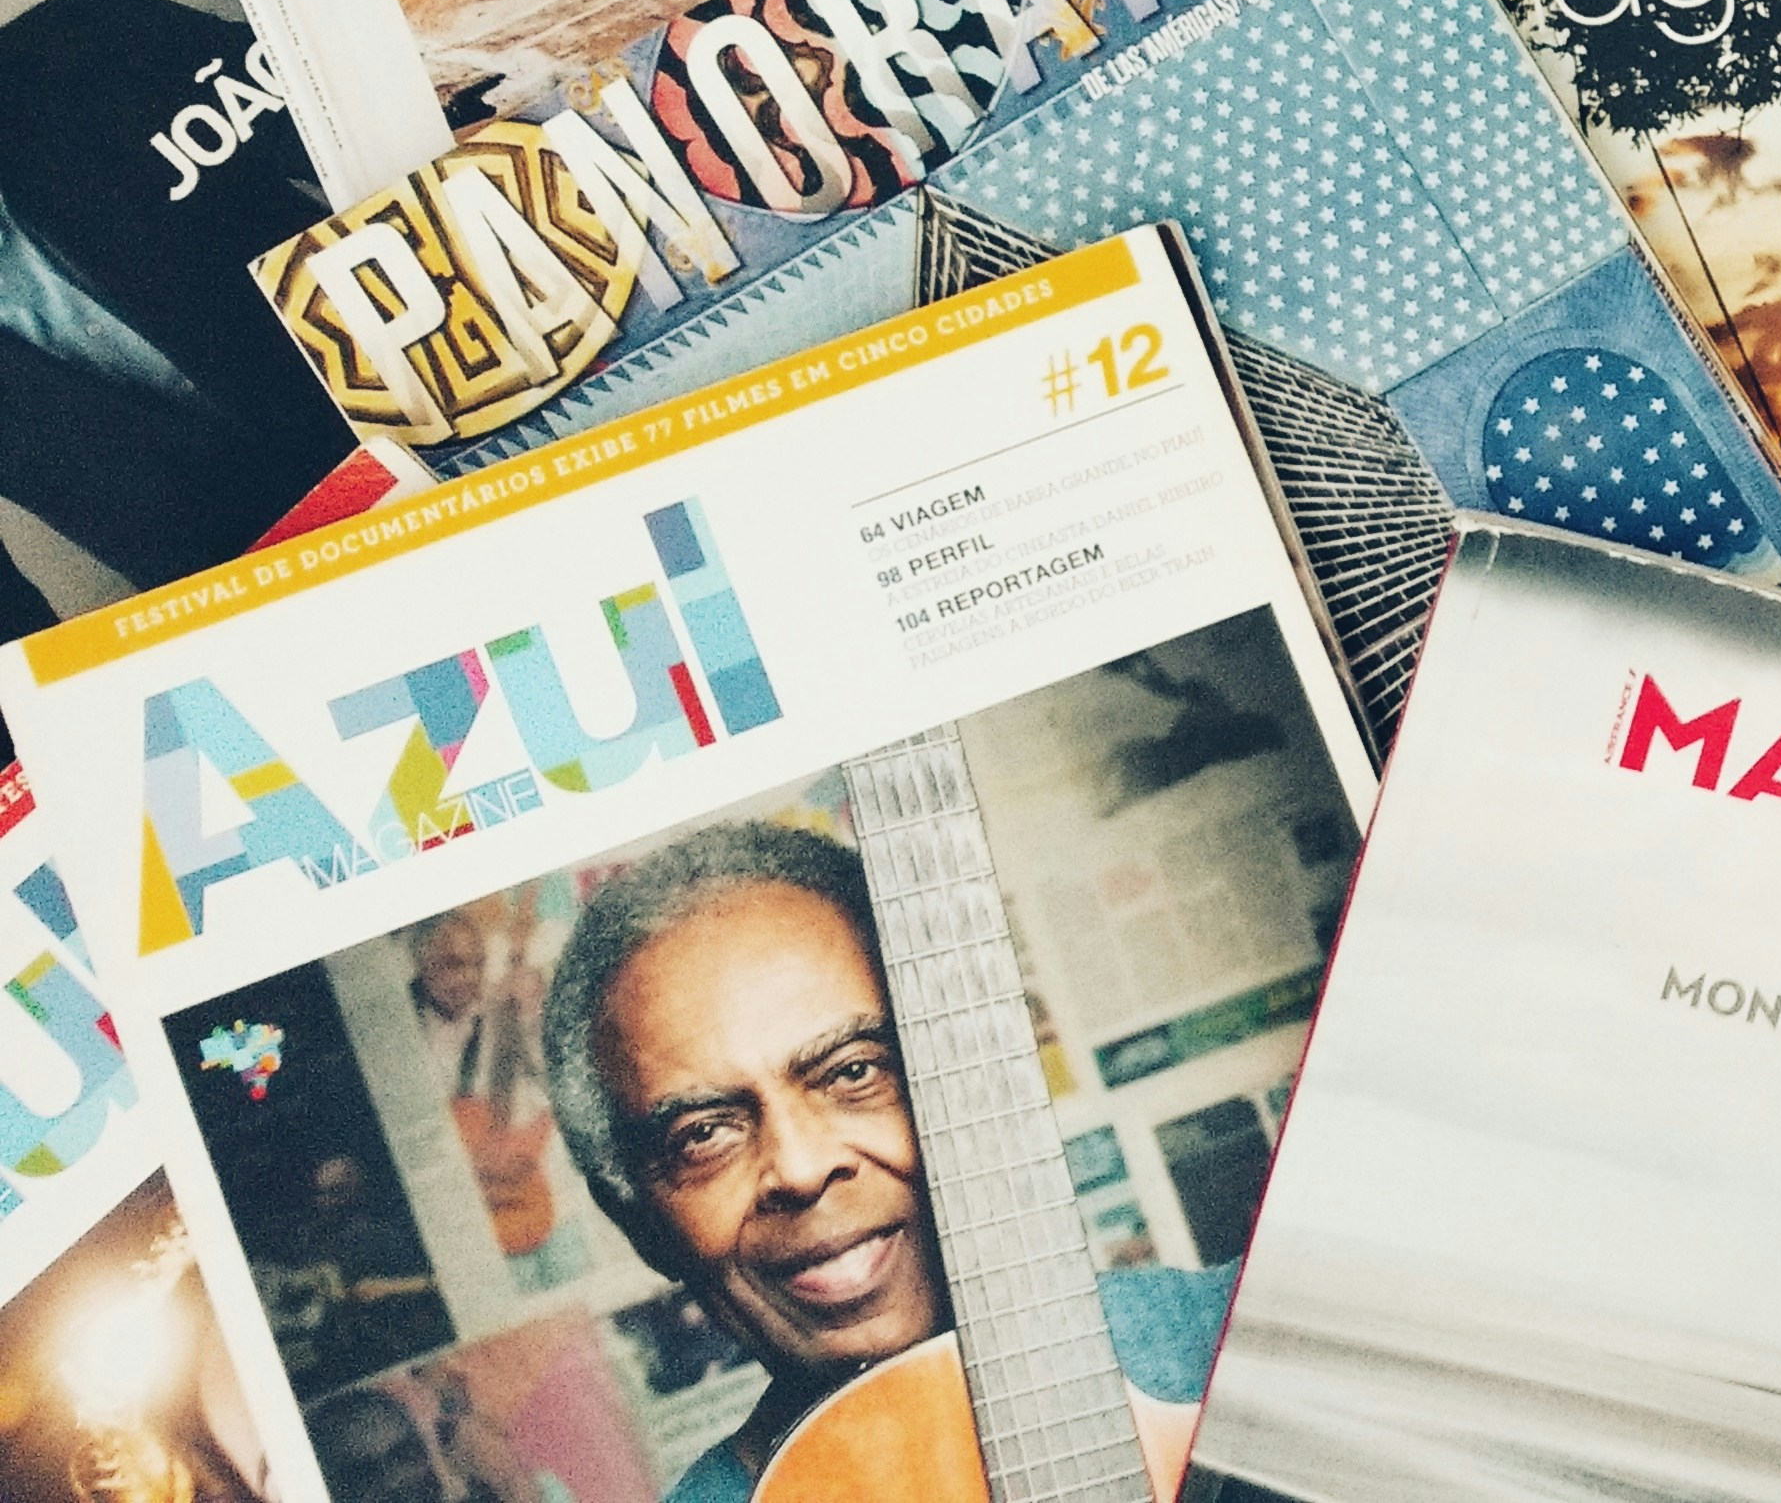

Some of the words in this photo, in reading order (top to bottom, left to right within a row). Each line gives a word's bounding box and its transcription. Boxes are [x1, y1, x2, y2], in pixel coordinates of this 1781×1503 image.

[1040, 322, 1171, 418] #12
[114, 574, 248, 638] FESTIVAL
[253, 558, 292, 587] DE
[300, 468, 546, 571] DOCUMENTÁRIOS
[555, 433, 637, 478] EXIBE
[645, 418, 674, 448] 77
[681, 379, 783, 432] FILMES
[790, 360, 832, 392] EM
[838, 325, 929, 372] CINCO
[937, 278, 1057, 336] CIDADES
[890, 485, 987, 532] VIAGEM
[908, 532, 995, 577] PERFIL
[896, 609, 931, 633] 104
[936, 543, 1105, 617] REPORTAGEM
[137, 497, 784, 957] Azul
